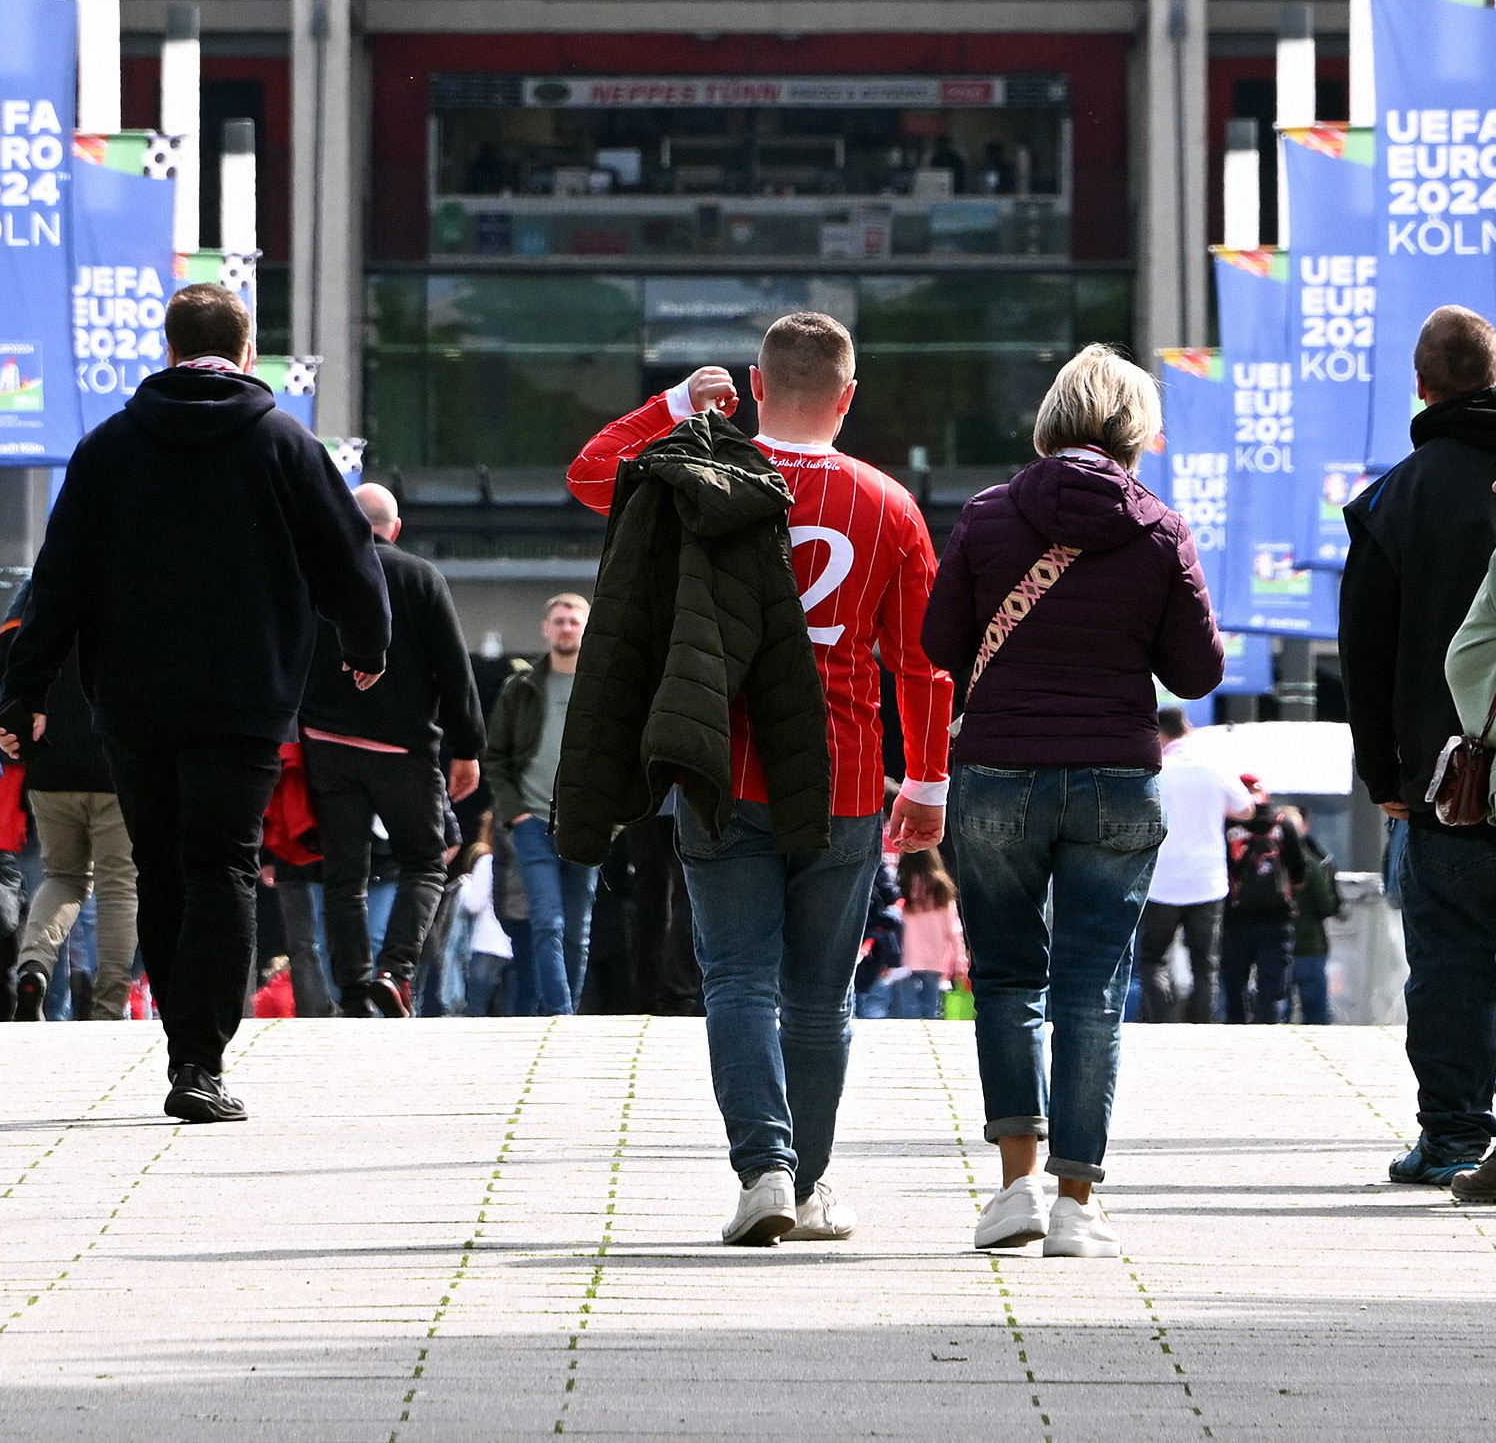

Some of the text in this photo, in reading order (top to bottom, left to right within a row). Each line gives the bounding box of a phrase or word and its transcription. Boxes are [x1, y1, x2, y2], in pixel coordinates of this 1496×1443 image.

[1301, 256, 1377, 286] UEF
[1301, 286, 1377, 317] EUR
[1301, 316, 1375, 348] 202
[1300, 346, 1374, 382] KÖL
